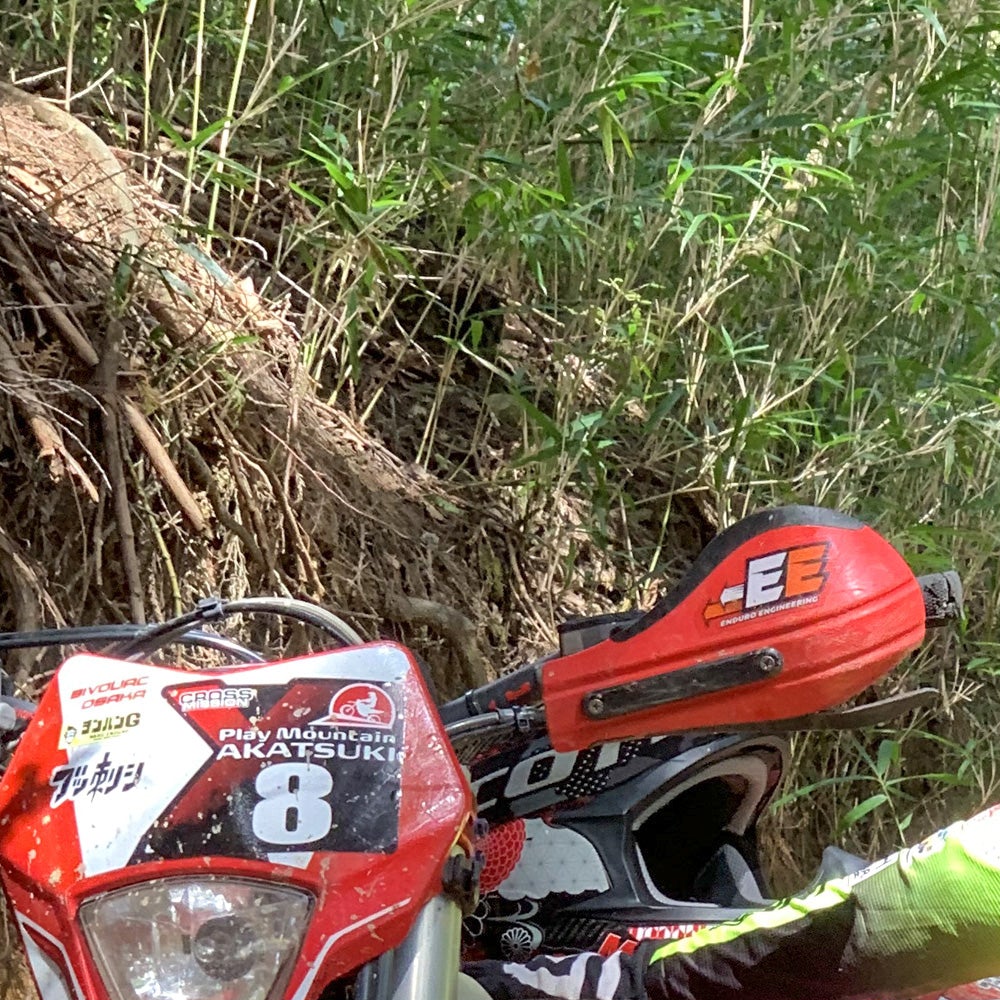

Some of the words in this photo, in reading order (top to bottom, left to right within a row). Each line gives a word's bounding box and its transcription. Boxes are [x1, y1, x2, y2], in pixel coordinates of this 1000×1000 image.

[720, 612, 757, 627] ENDURO
[758, 596, 819, 617] ENGINEERING
[81, 690, 147, 710] OSAKA
[179, 687, 253, 704] CROSS
[181, 698, 250, 712] MISSION
[219, 728, 271, 743] Play
[276, 727, 396, 744] Mountain
[216, 741, 396, 762] AKATSUKI
[252, 762, 334, 845] 8
